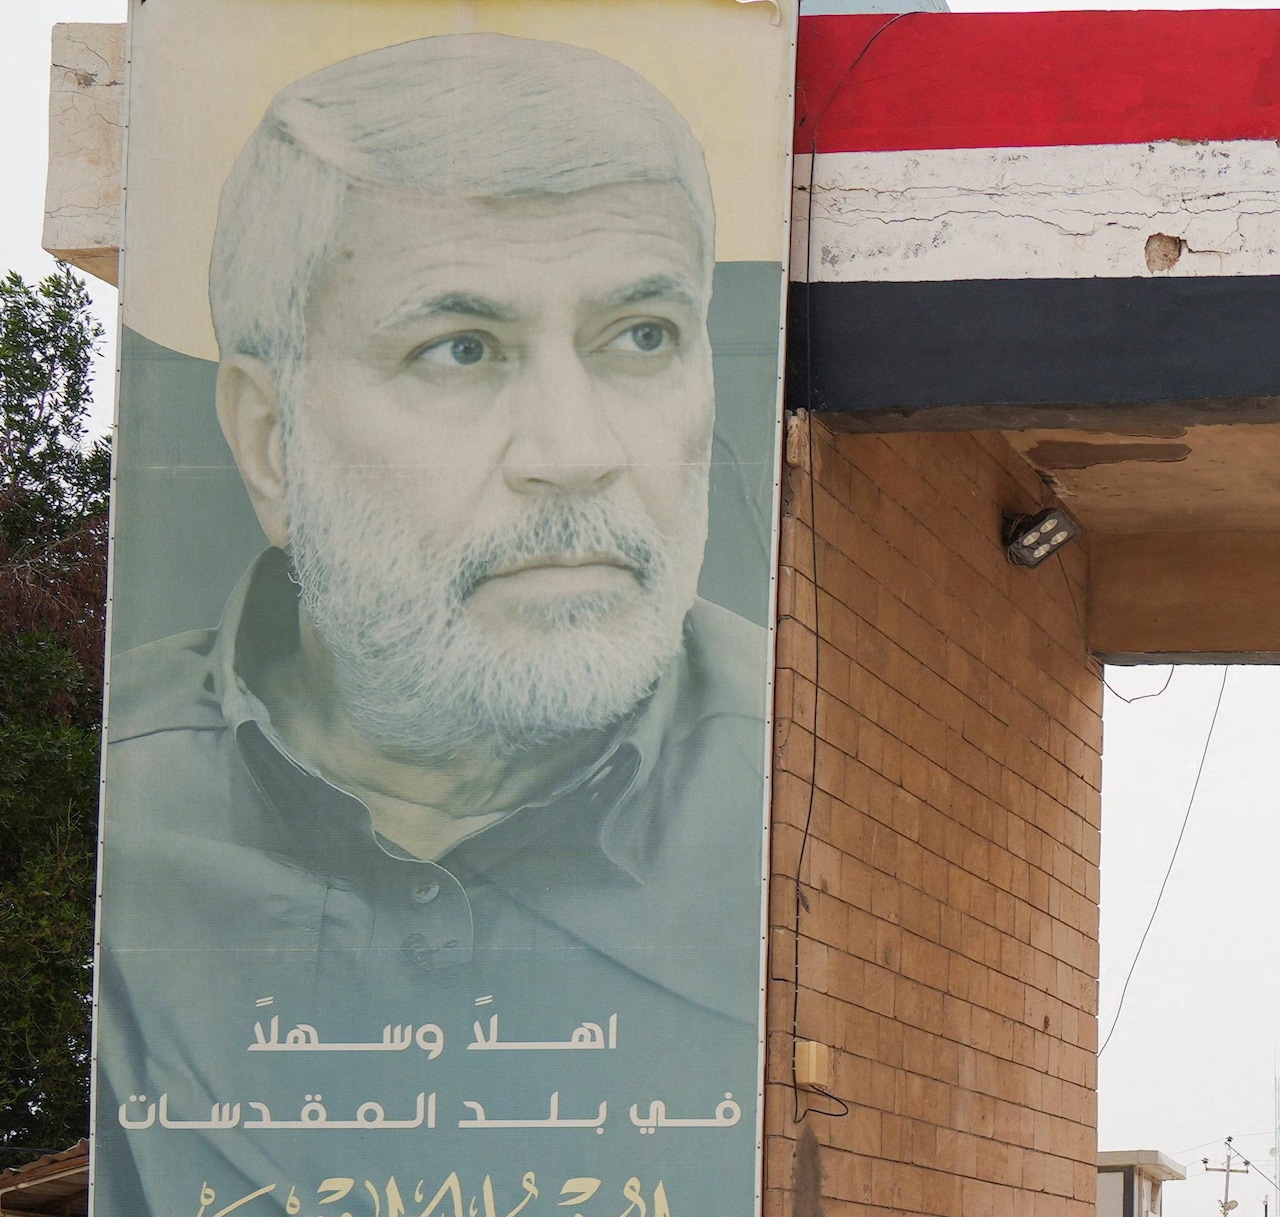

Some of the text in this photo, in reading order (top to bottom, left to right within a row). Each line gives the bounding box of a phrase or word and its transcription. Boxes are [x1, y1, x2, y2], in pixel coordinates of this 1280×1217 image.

[117, 1090, 743, 1136] في بلد المقدسات
